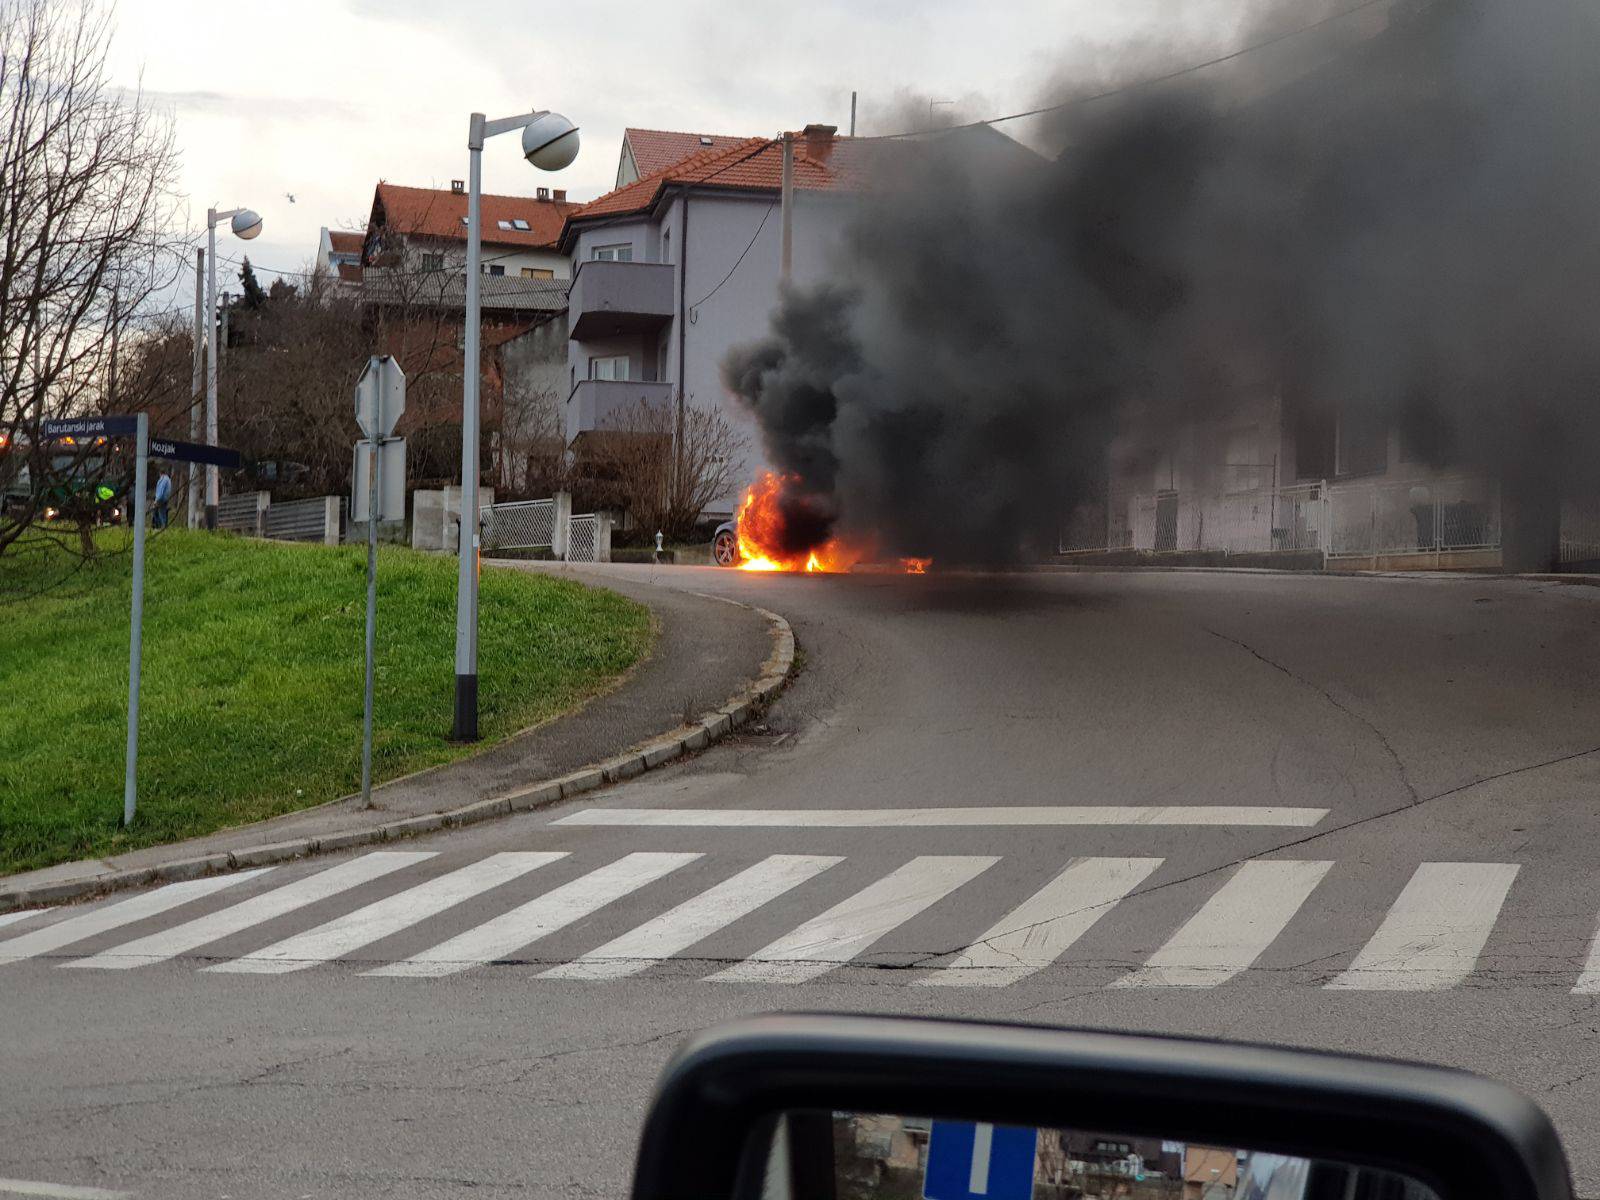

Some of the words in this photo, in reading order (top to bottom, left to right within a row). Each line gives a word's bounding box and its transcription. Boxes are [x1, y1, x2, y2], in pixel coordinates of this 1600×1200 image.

[48, 422, 86, 434] Barutanski
[86, 421, 105, 433] jarak
[151, 442, 176, 455] Kozjak
